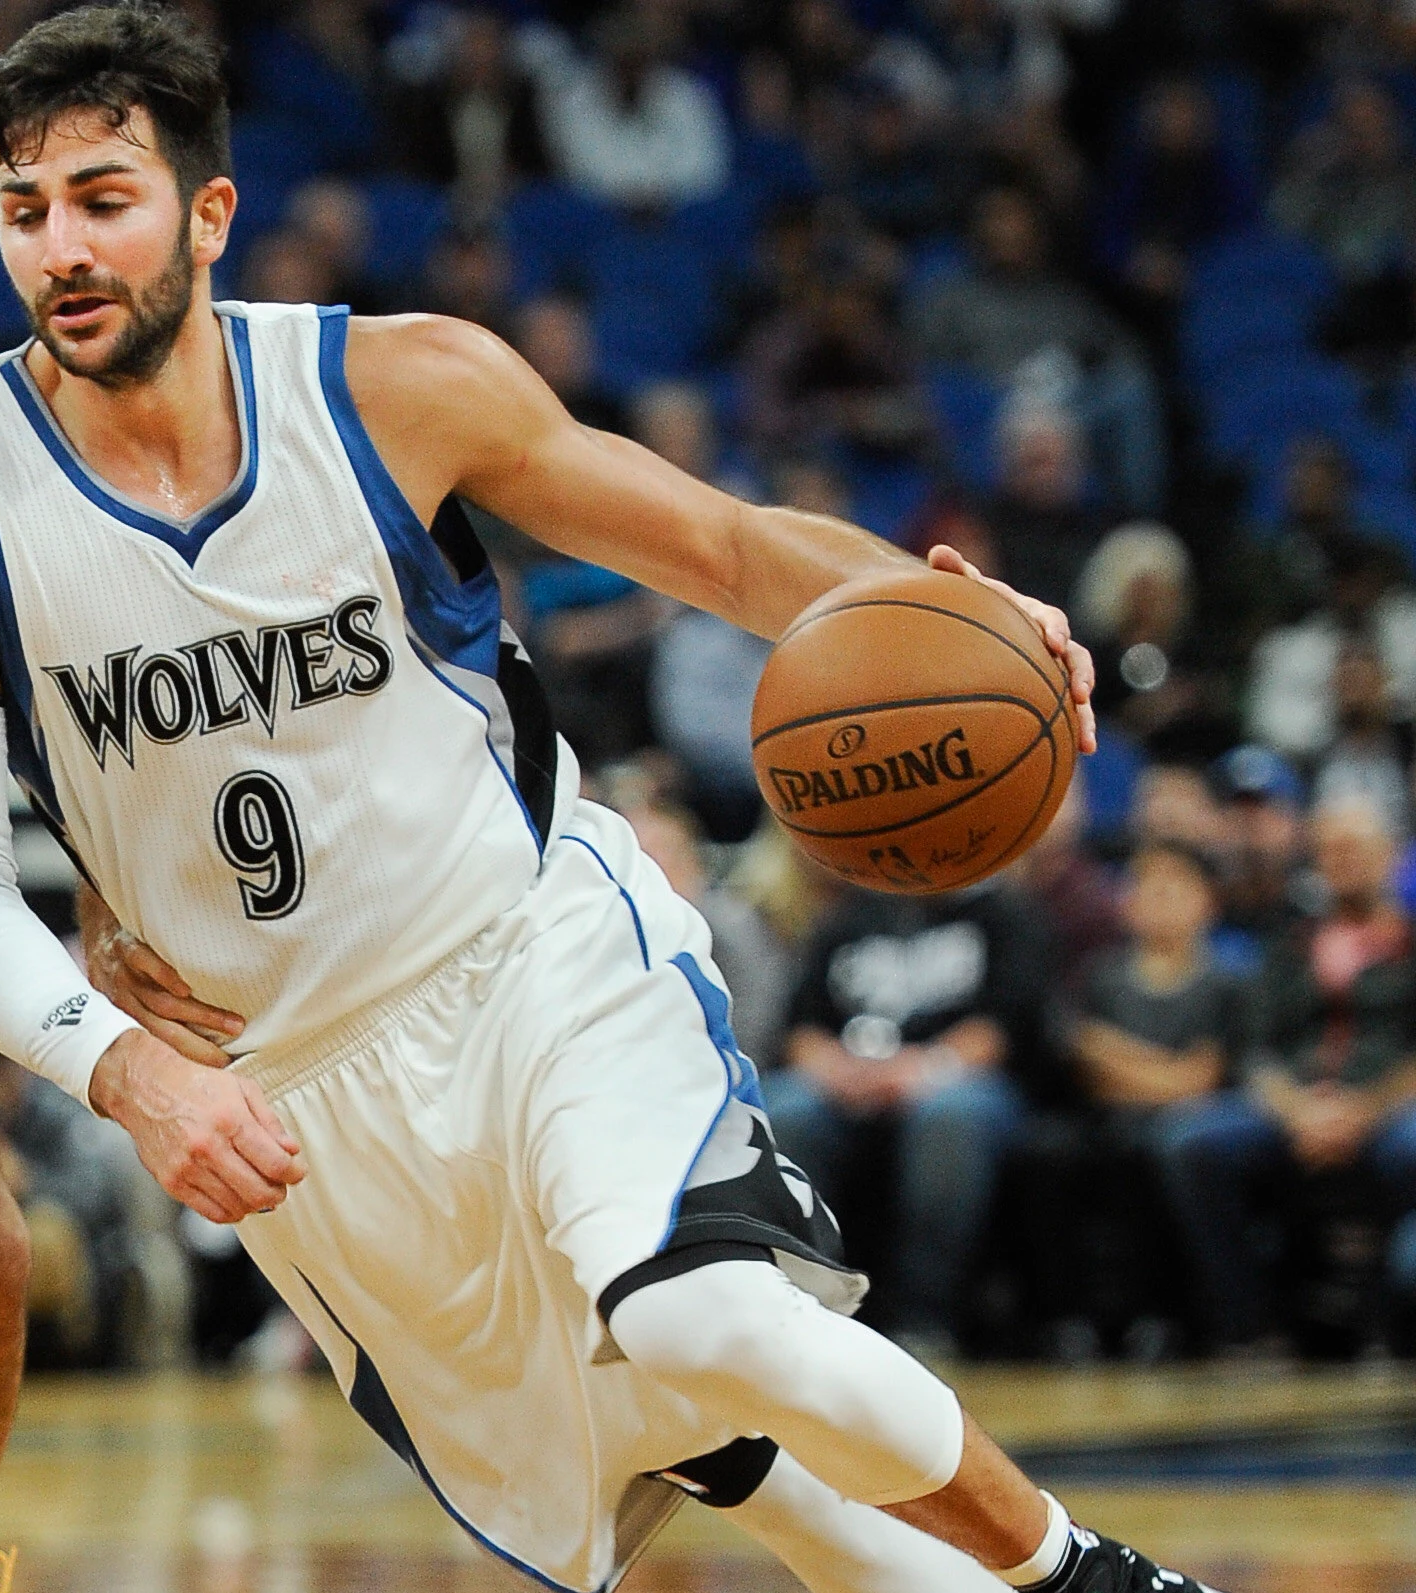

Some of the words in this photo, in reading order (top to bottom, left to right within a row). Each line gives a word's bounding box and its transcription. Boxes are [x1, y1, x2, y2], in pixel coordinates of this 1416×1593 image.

[40, 595, 395, 774] WOLVES
[768, 727, 975, 812] SPALDING
[213, 769, 306, 921] 9
[41, 992, 90, 1032] adidas
